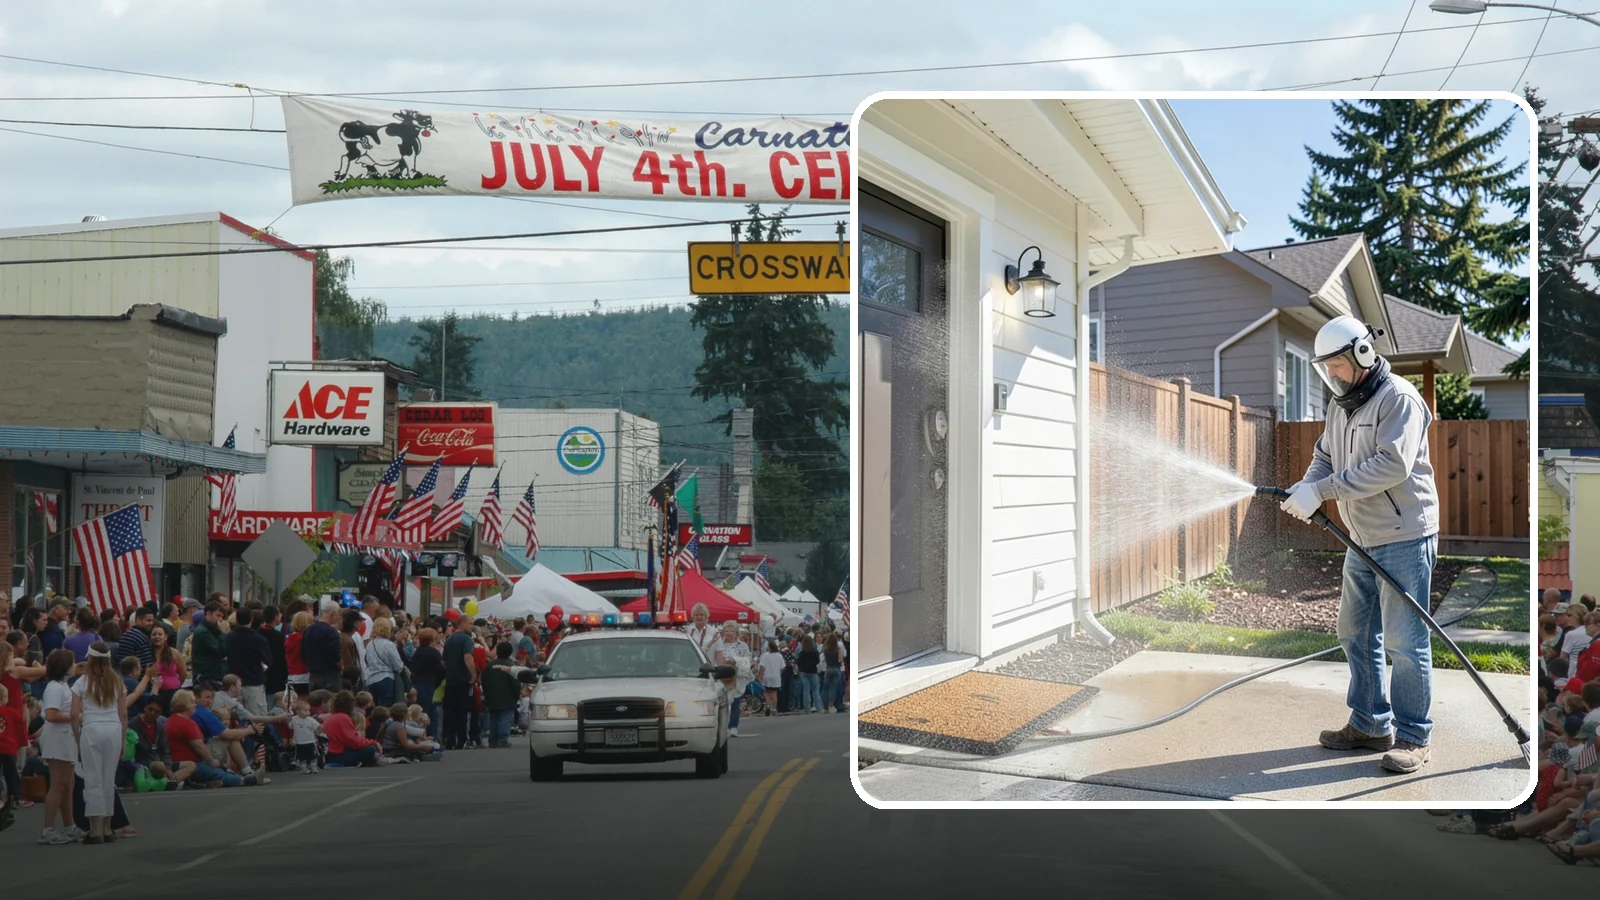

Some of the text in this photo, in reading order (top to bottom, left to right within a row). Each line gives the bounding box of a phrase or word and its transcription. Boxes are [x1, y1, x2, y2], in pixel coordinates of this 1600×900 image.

[695, 121, 850, 149] Carnat
[481, 141, 605, 192] JULY
[632, 150, 746, 198] 4th.
[697, 254, 850, 280] CROSSWA
[282, 380, 373, 420] ACE
[405, 408, 453, 422] CEDAR
[283, 421, 371, 436] Hardware
[416, 428, 476, 447] Coca-Cola
[96, 485, 125, 494] Vincent
[126, 486, 136, 495] de
[137, 486, 155, 496] Paul
[688, 526, 741, 535] CRNATION
[699, 535, 730, 543] GLASS
